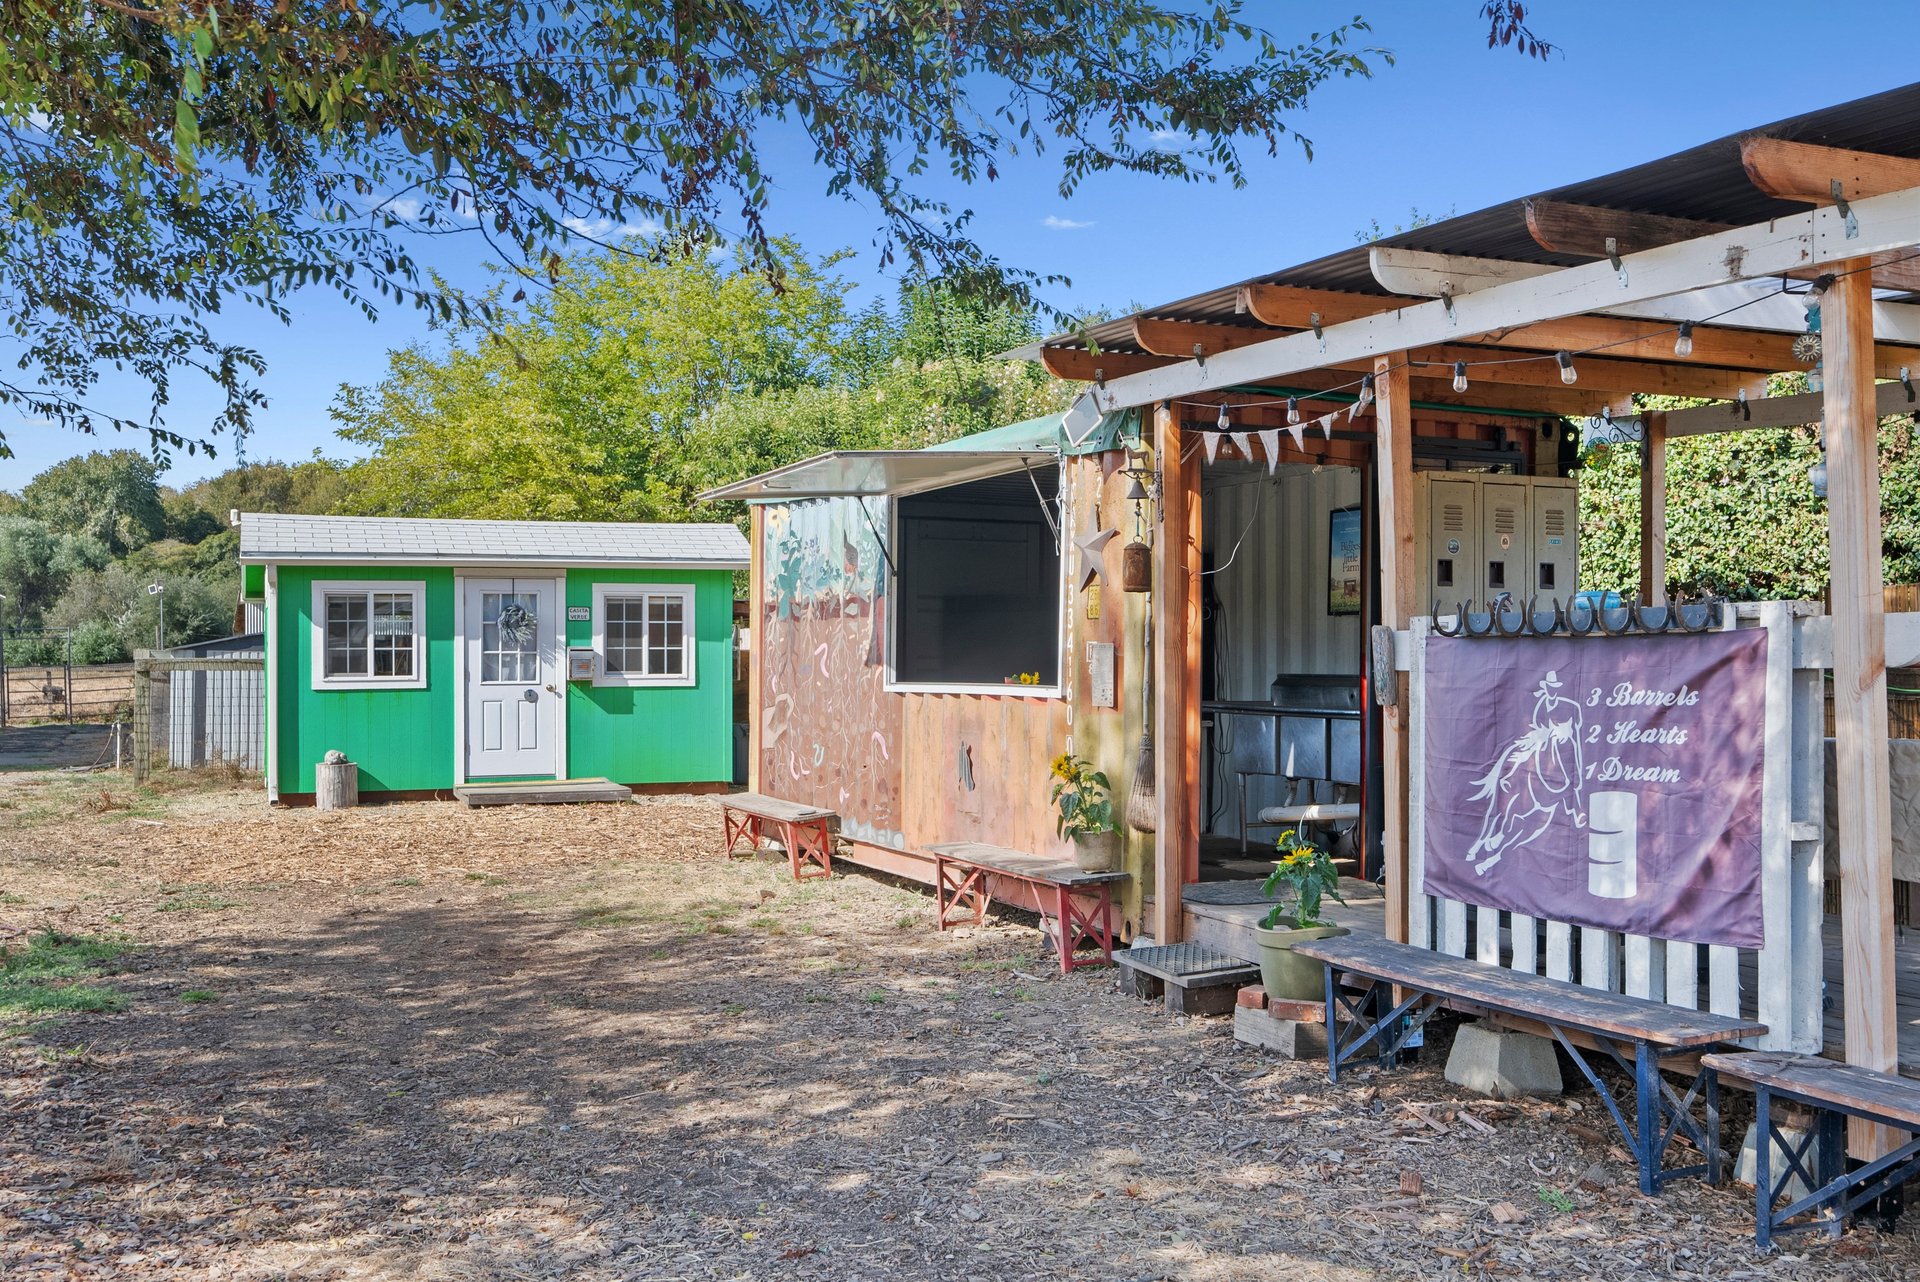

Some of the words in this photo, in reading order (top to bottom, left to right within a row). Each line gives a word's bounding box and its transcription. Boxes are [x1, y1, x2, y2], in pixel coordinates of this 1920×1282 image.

[1586, 687, 1602, 707] 3
[1605, 681, 1700, 707] Barrels
[1585, 724, 1602, 744] 2
[1606, 720, 1689, 745] Hearts
[1585, 762, 1598, 780] 1
[1597, 756, 1681, 783] Dream
